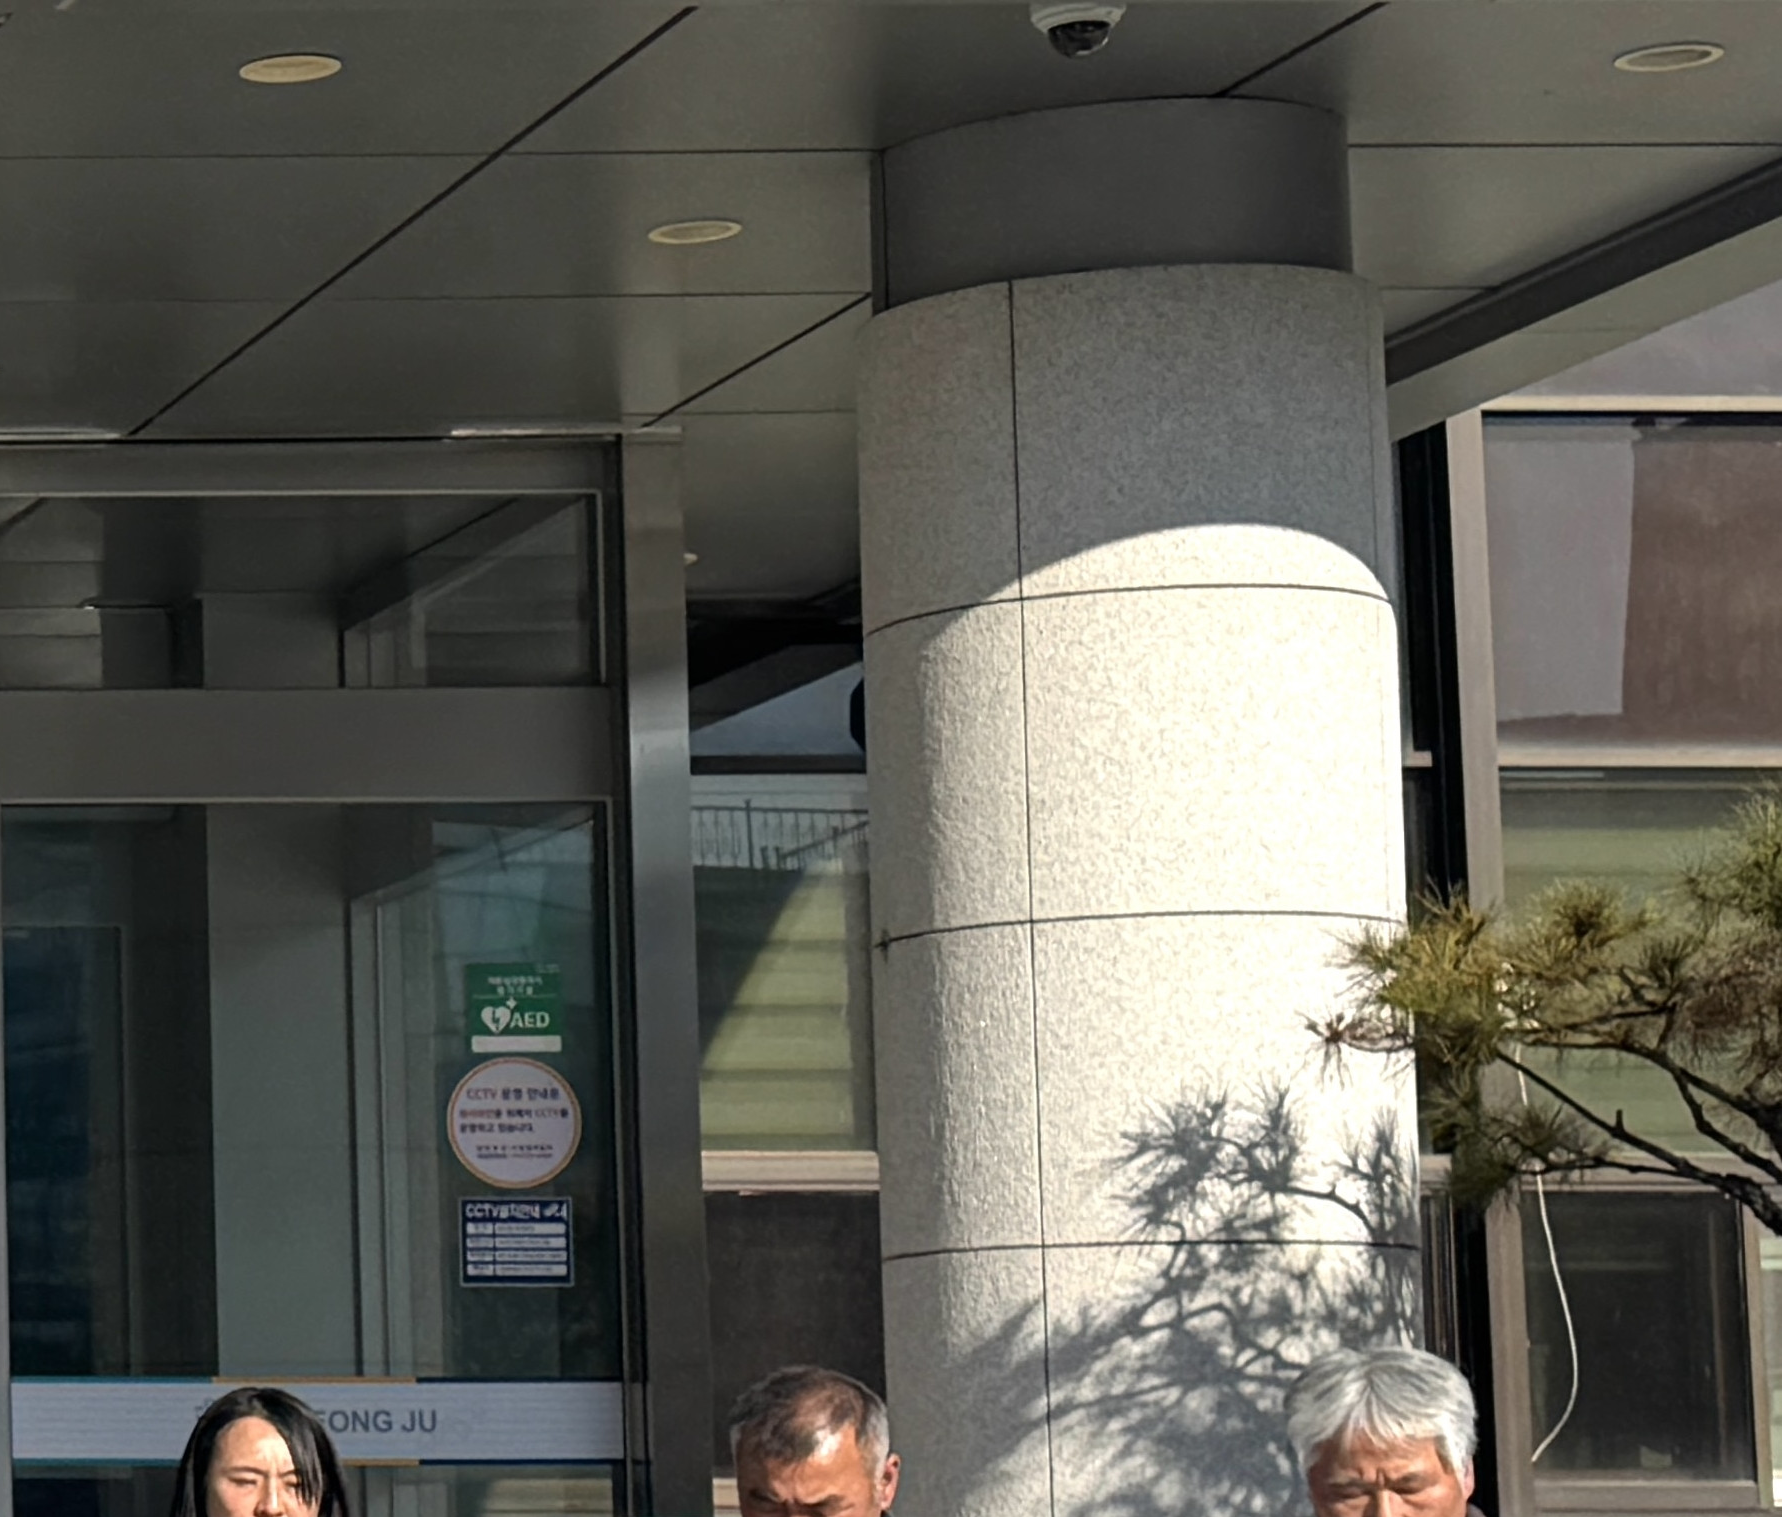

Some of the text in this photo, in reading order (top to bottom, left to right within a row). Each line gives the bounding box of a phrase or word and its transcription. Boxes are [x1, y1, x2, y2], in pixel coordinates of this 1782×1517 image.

[509, 1011, 551, 1029] AED
[466, 1087, 497, 1100] CCTV
[400, 1409, 437, 1434] JU
